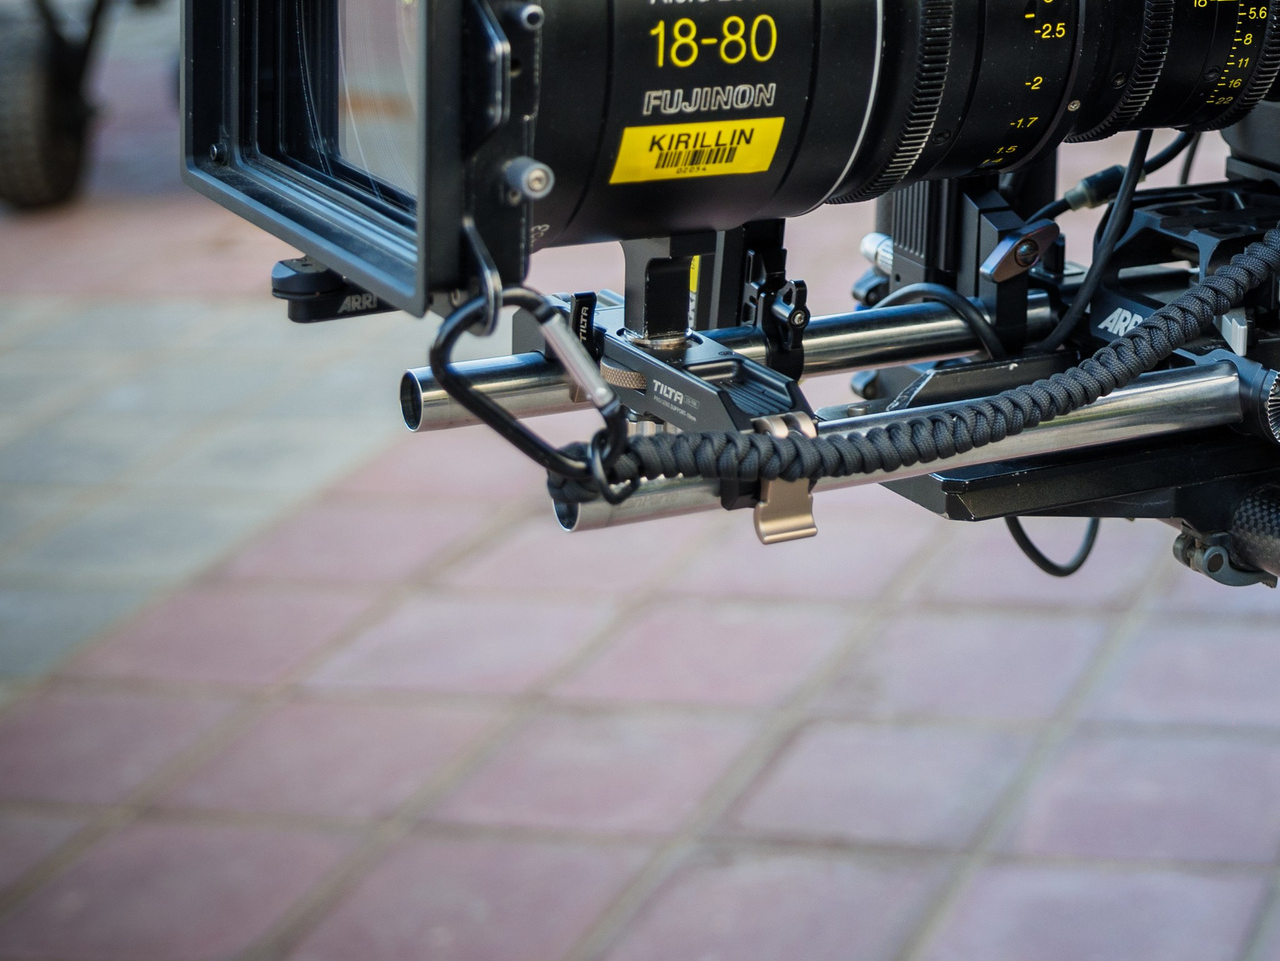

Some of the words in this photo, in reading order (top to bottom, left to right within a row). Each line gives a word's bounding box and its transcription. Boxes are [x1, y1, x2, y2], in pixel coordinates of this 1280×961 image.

[1248, 7, 1268, 20] 5.6
[650, 14, 778, 68] 18-80
[1243, 33, 1253, 45] 8
[1238, 57, 1250, 68] 11
[1229, 79, 1242, 88] 16
[642, 82, 777, 116] FUJINON
[1215, 96, 1233, 105] 22
[649, 128, 755, 152] KIRILLIN
[337, 292, 377, 314] ARRI
[579, 306, 589, 343] TILTA
[1097, 307, 1145, 336] ARR
[652, 379, 684, 405] TILTA
